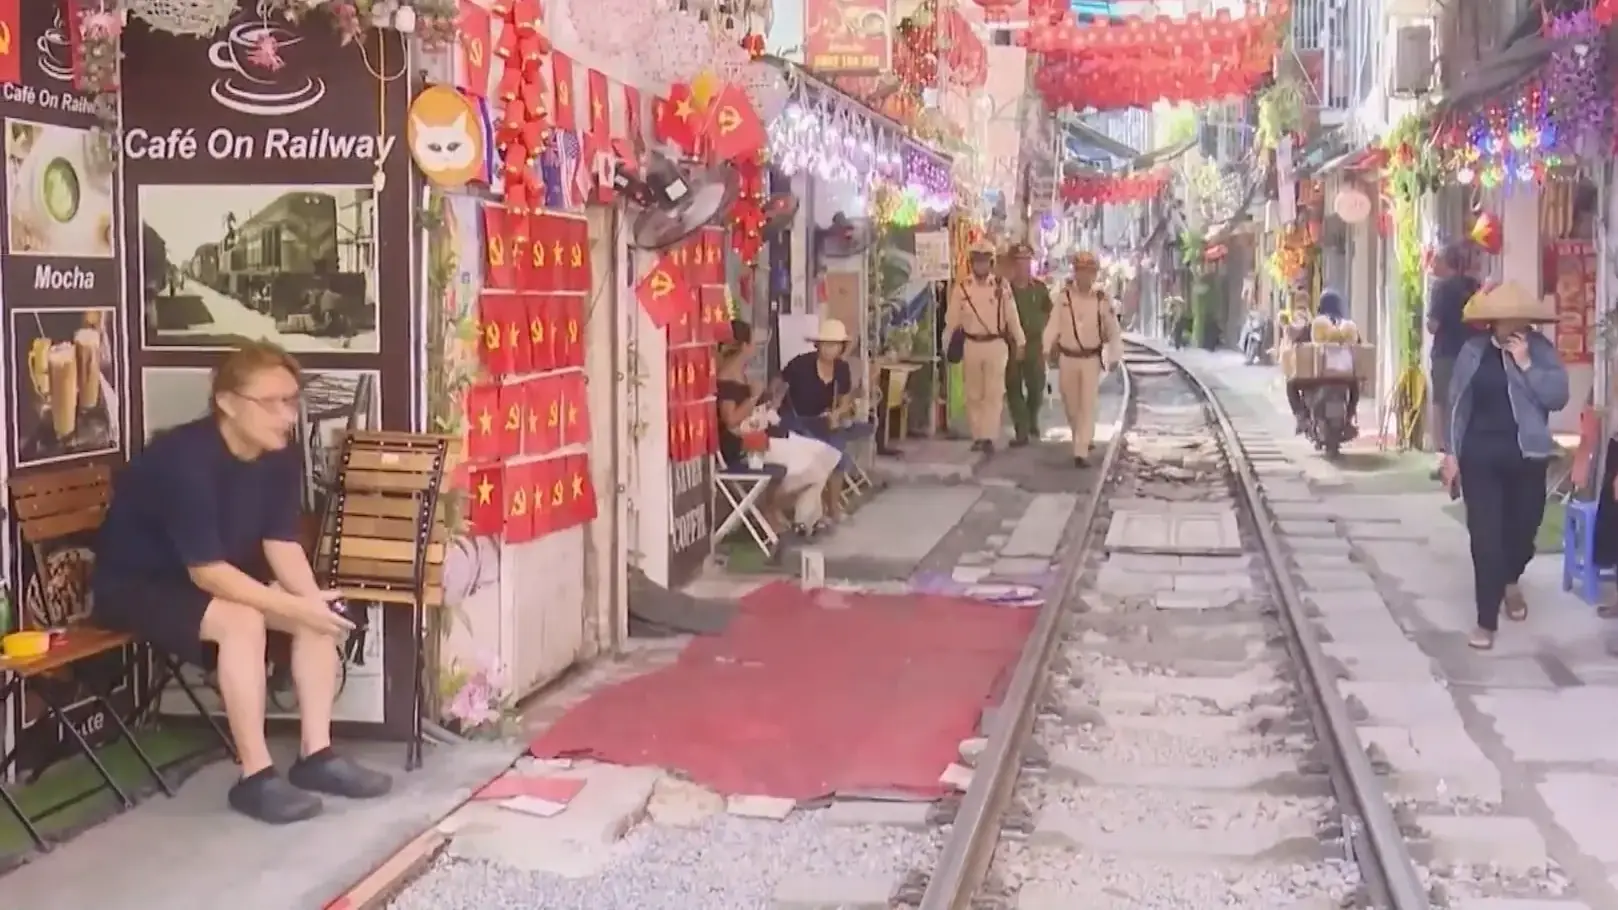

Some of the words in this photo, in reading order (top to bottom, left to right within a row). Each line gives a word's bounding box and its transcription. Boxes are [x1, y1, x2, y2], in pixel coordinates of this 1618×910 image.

[3, 81, 35, 105] Café
[39, 89, 58, 109] On
[124, 127, 197, 159] Café
[207, 128, 254, 159] On
[264, 128, 396, 166] Railway
[34, 264, 95, 290] Mocha
